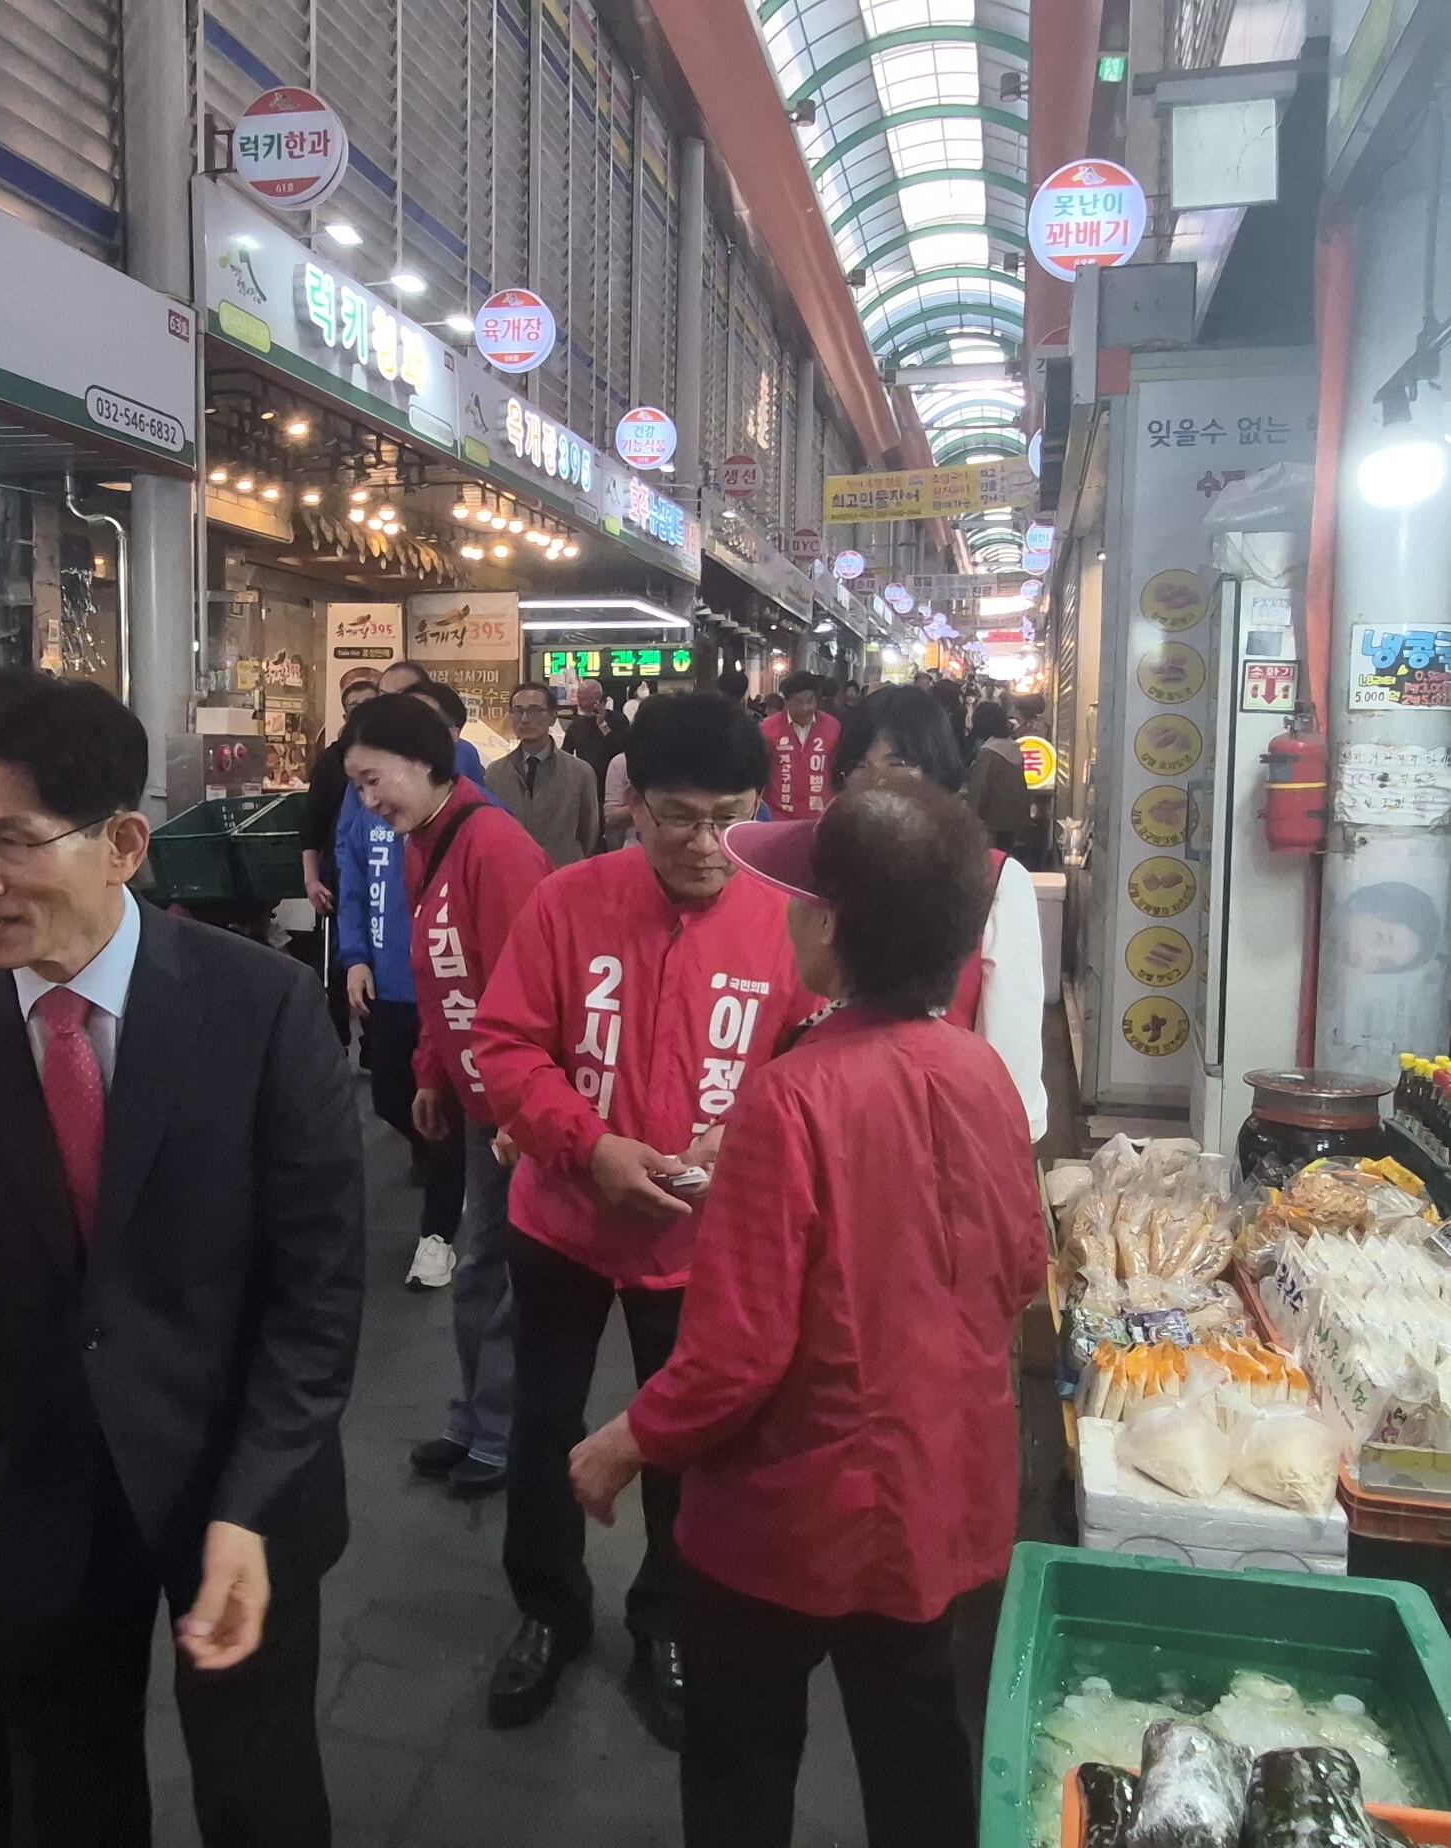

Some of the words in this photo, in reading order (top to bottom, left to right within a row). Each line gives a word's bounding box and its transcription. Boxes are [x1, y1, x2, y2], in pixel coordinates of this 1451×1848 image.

[239, 129, 330, 162] 럭키한과
[1053, 193, 1124, 217] 못난이
[1044, 219, 1129, 249] 꽈배기
[481, 317, 543, 343] 육개장
[96, 396, 177, 446] 032-546-6832
[1147, 418, 1228, 448] 잊을수
[1237, 416, 1290, 446] 없는
[813, 738, 824, 751] 2
[368, 847, 389, 948] 구의원
[584, 955, 623, 1011] 2
[691, 995, 759, 1134] 이정
